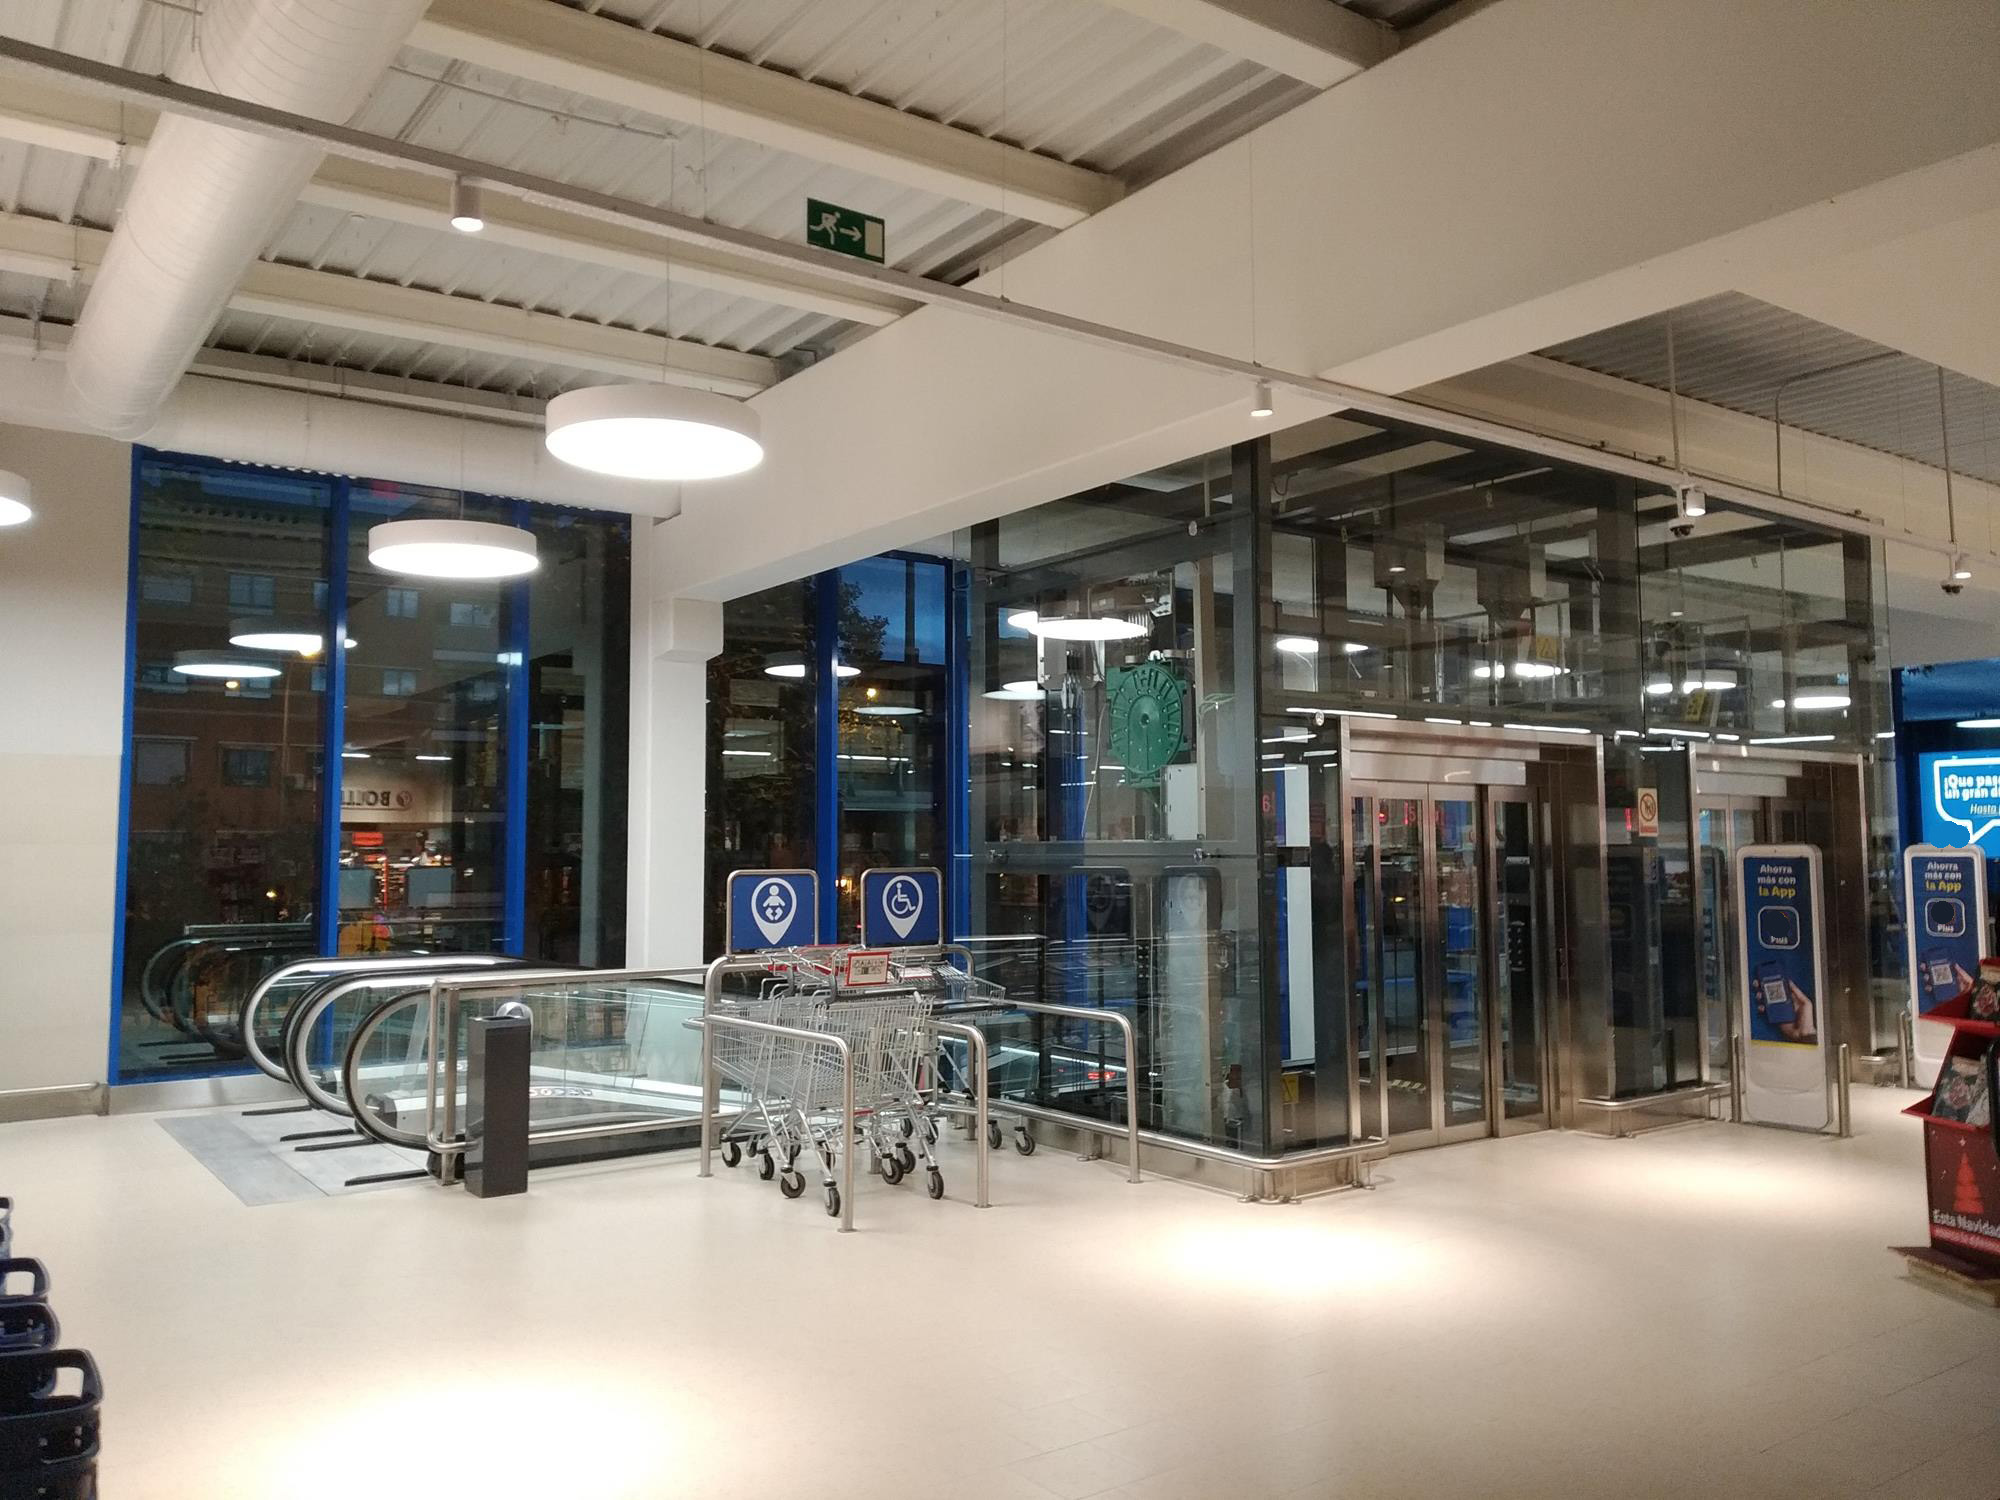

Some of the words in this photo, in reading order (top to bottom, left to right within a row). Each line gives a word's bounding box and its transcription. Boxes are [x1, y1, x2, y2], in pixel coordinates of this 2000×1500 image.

[1760, 864, 1793, 874] Ahorra
[1927, 861, 1959, 871] Ahorra
[1757, 876, 1777, 885] más
[1778, 876, 1796, 885] con
[1924, 870, 1943, 880] más
[1944, 871, 1962, 881] con
[1926, 880, 1937, 891] la
[1938, 880, 1962, 893] App
[1759, 886, 1770, 896] la
[1772, 886, 1796, 899] App
